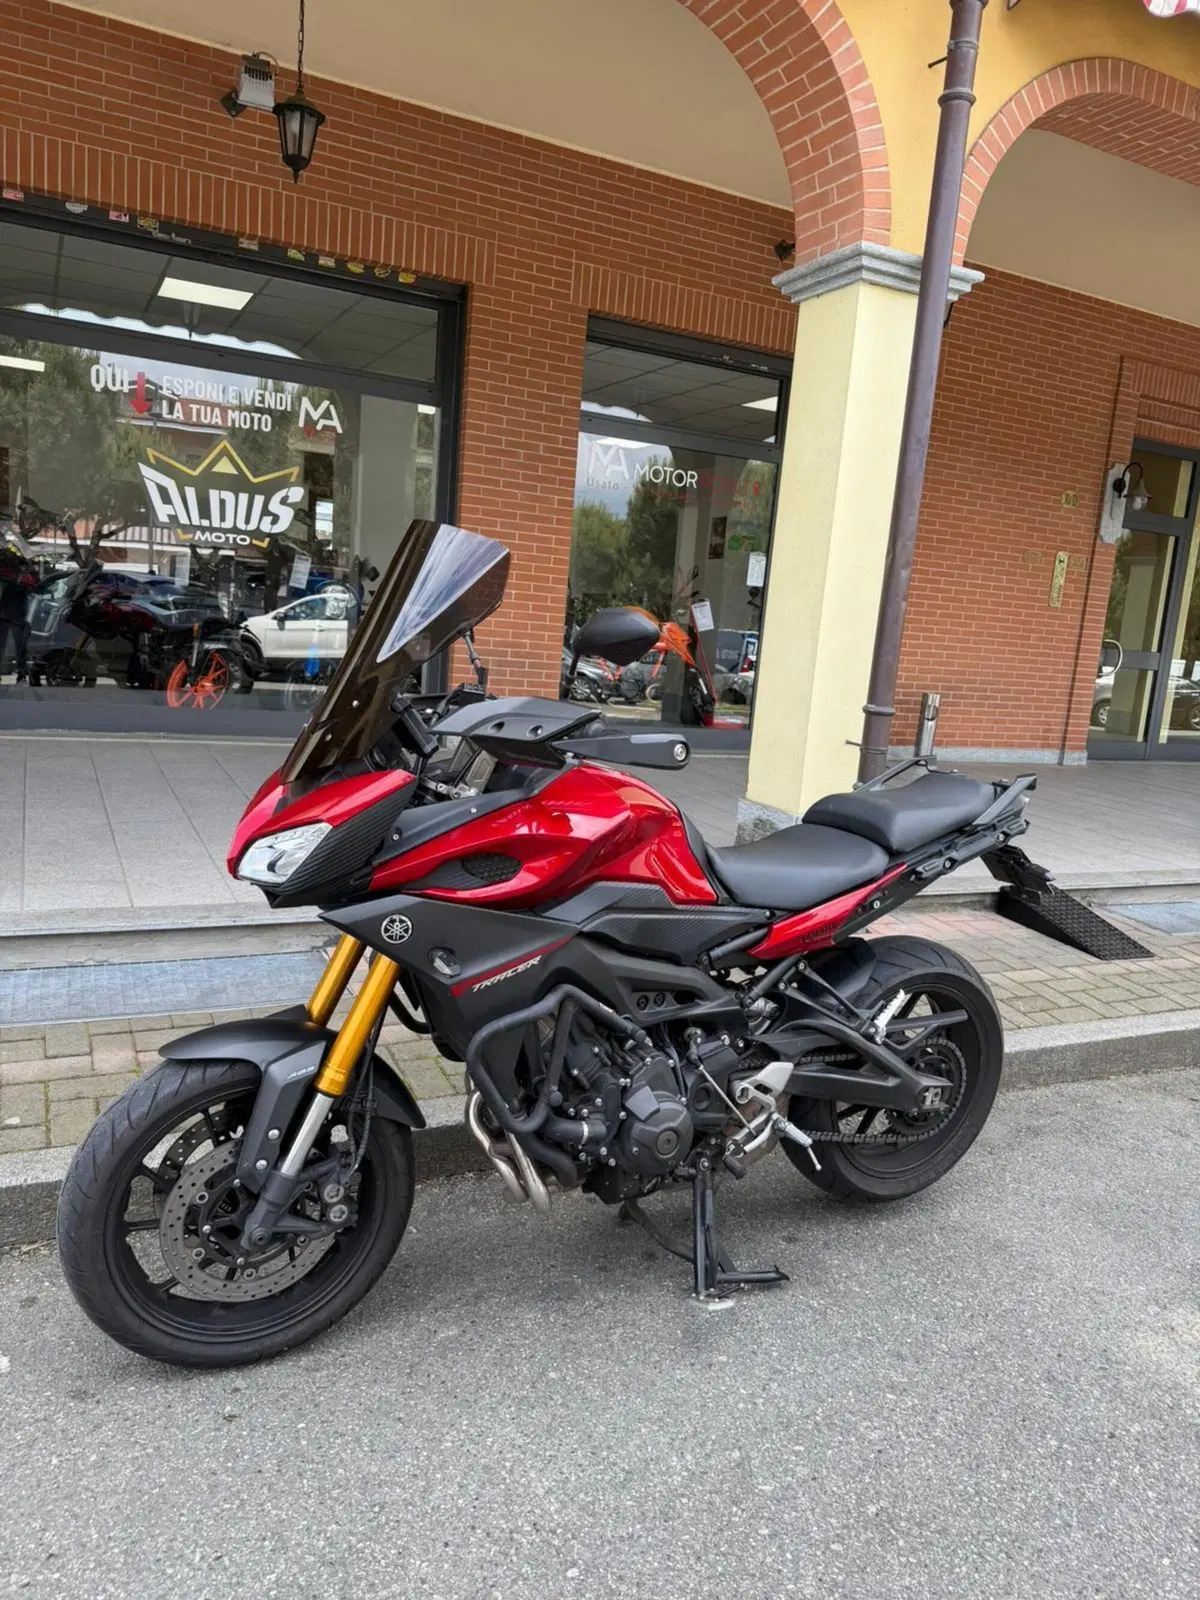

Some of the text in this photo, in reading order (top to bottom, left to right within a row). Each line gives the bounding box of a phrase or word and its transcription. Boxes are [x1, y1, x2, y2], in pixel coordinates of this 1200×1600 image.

[90, 364, 129, 393] QUI
[161, 375, 292, 412] ESPONI E VENDI
[161, 400, 272, 432] LA TUA MOTO
[138, 462, 304, 534] ALDUS
[586, 477, 620, 491] Usato
[193, 532, 250, 546] MOTO
[472, 955, 543, 992] TRACER
